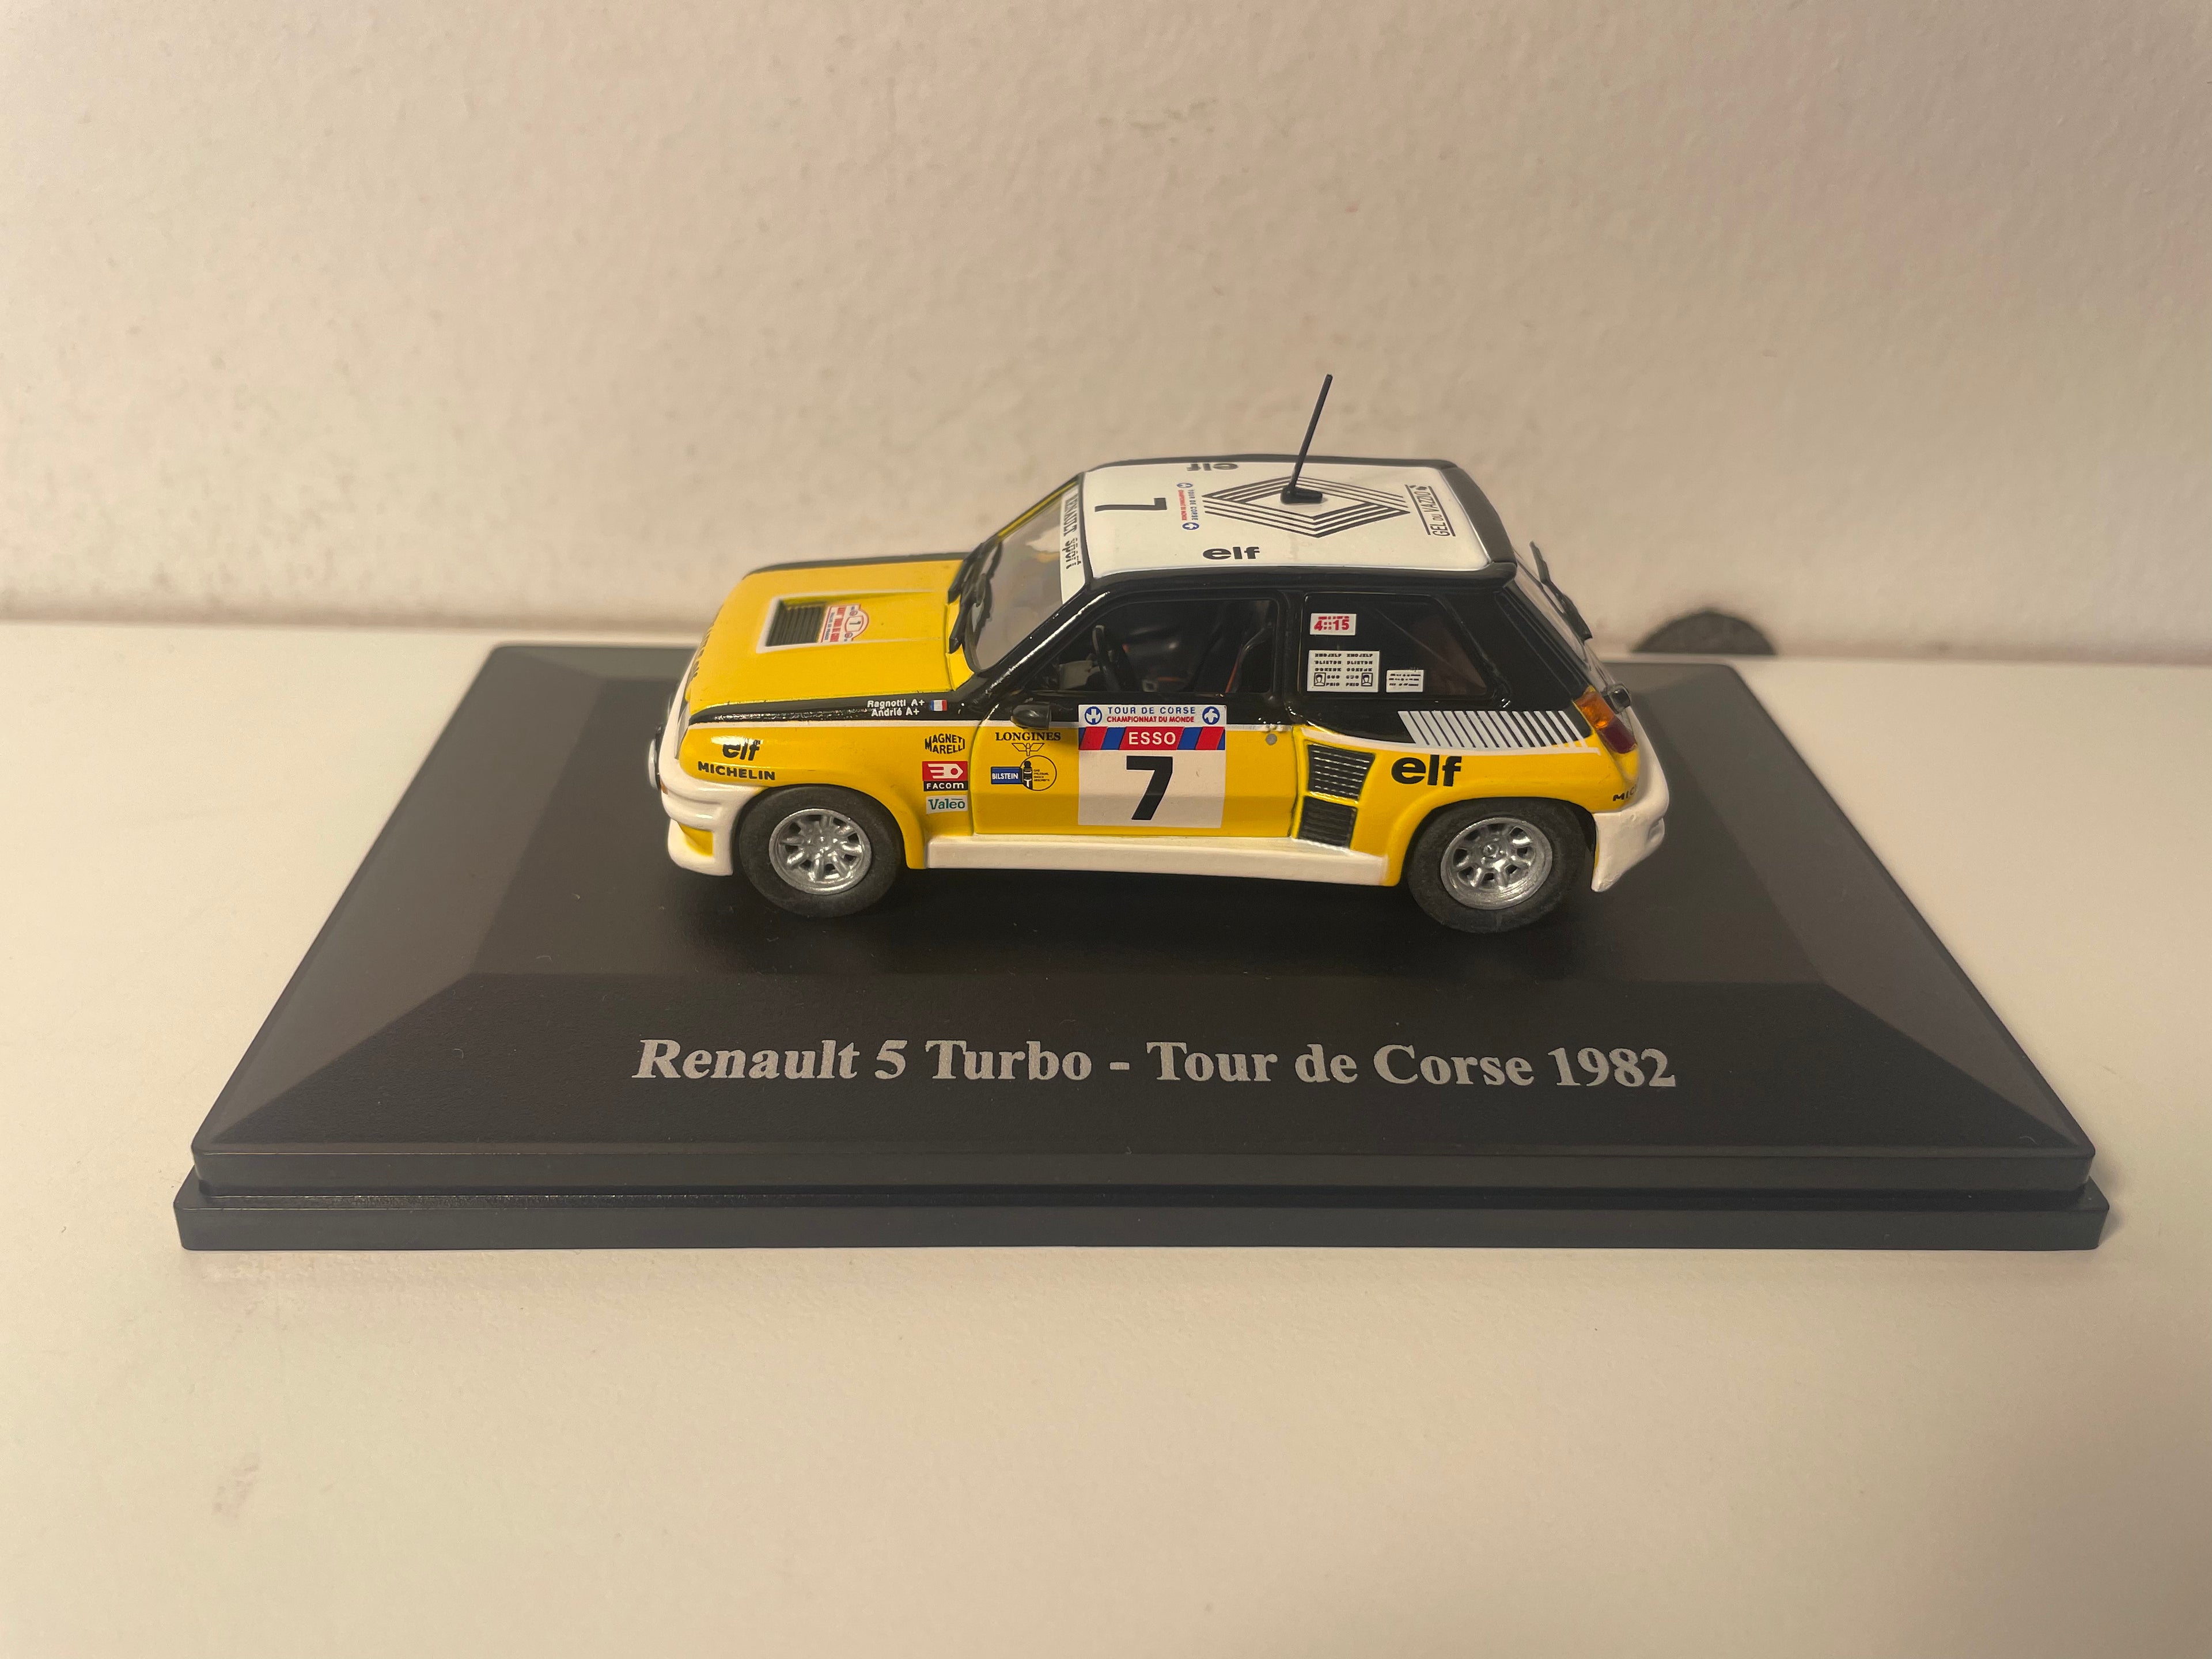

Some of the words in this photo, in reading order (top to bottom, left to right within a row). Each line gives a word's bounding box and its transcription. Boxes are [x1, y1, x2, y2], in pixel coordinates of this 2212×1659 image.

[1094, 498, 1167, 512] 7
[1414, 491, 1440, 512] VAZZIO
[1430, 522, 1450, 536] GEL
[1202, 546, 1260, 560] elf
[867, 699, 906, 709] Ragnotti
[911, 699, 925, 707] A+
[906, 706, 920, 715] A+
[1160, 706, 1195, 714] CORSE
[925, 733, 965, 748] MAGNETI
[995, 732, 1061, 741] LONGINES
[1128, 732, 1176, 745] ESSO
[722, 738, 760, 760] elf
[698, 761, 775, 781] MICHELIN
[1391, 755, 1461, 787] elf
[1126, 755, 1173, 820] 7
[928, 798, 965, 810] Valeo
[632, 1039, 859, 1079] Renault
[875, 1040, 907, 1079] 5
[925, 1040, 1092, 1080] Turbo
[1109, 1062, 1129, 1070] -
[1146, 1041, 1277, 1081] Tour
[1295, 1044, 1357, 1083] de
[1373, 1044, 1533, 1085] Corse
[1547, 1047, 1675, 1087] 1982
